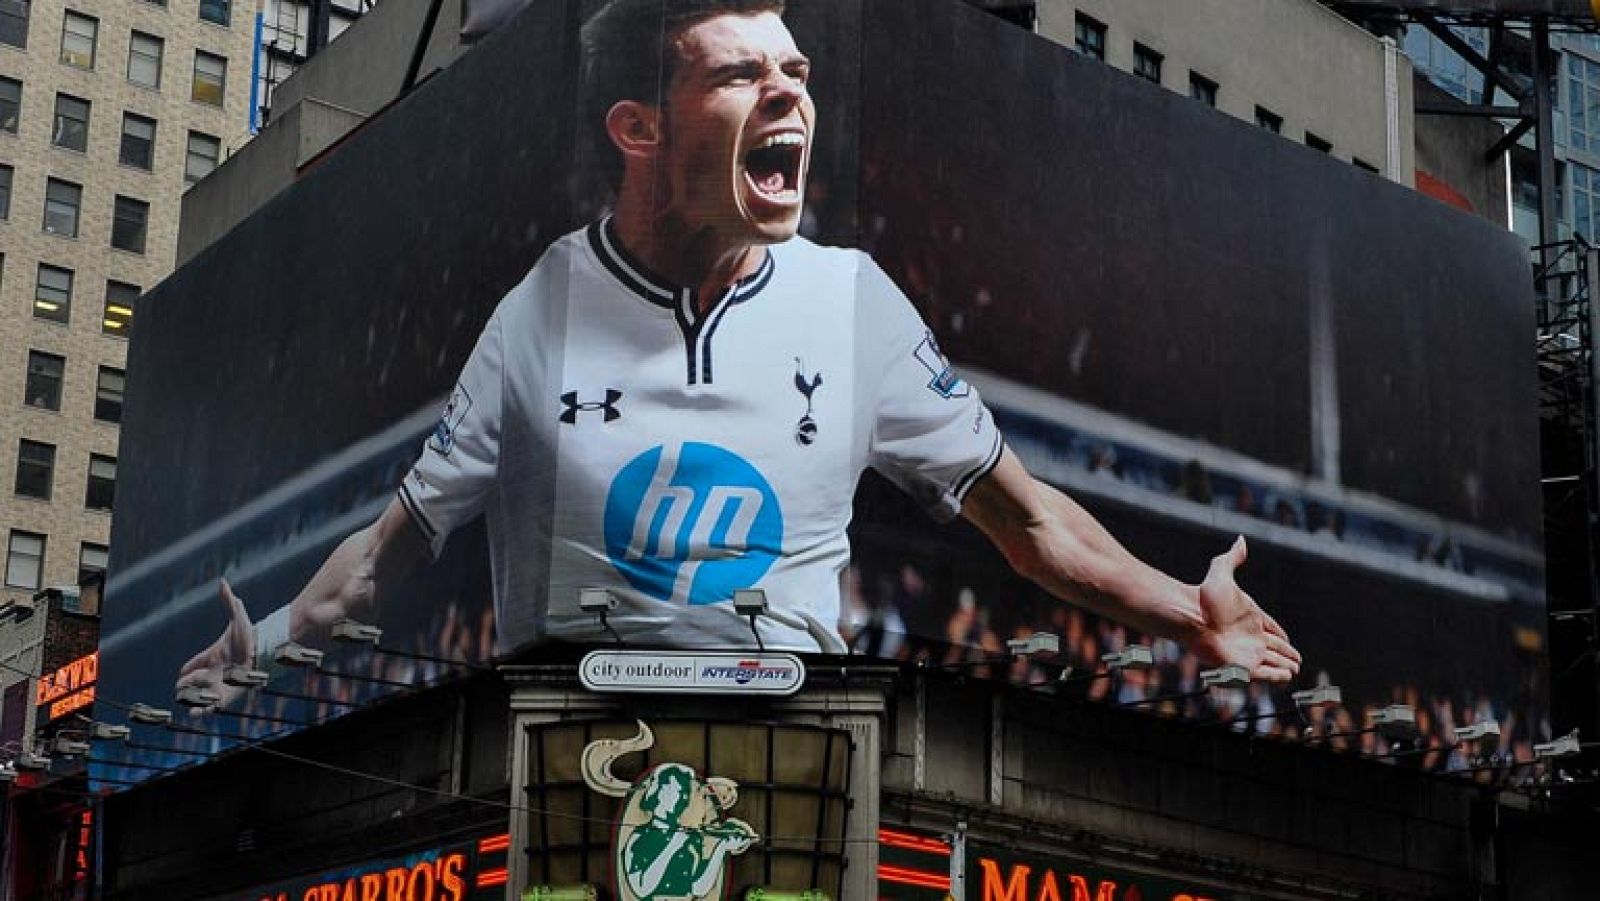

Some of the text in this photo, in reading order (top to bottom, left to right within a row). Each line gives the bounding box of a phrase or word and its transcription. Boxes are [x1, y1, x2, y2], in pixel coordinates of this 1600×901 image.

[624, 441, 764, 603] hp
[592, 661, 693, 681] city outdoor
[701, 666, 794, 682] INTERSTATE
[303, 854, 466, 901] RRO'S
[979, 858, 1144, 901] MAM
